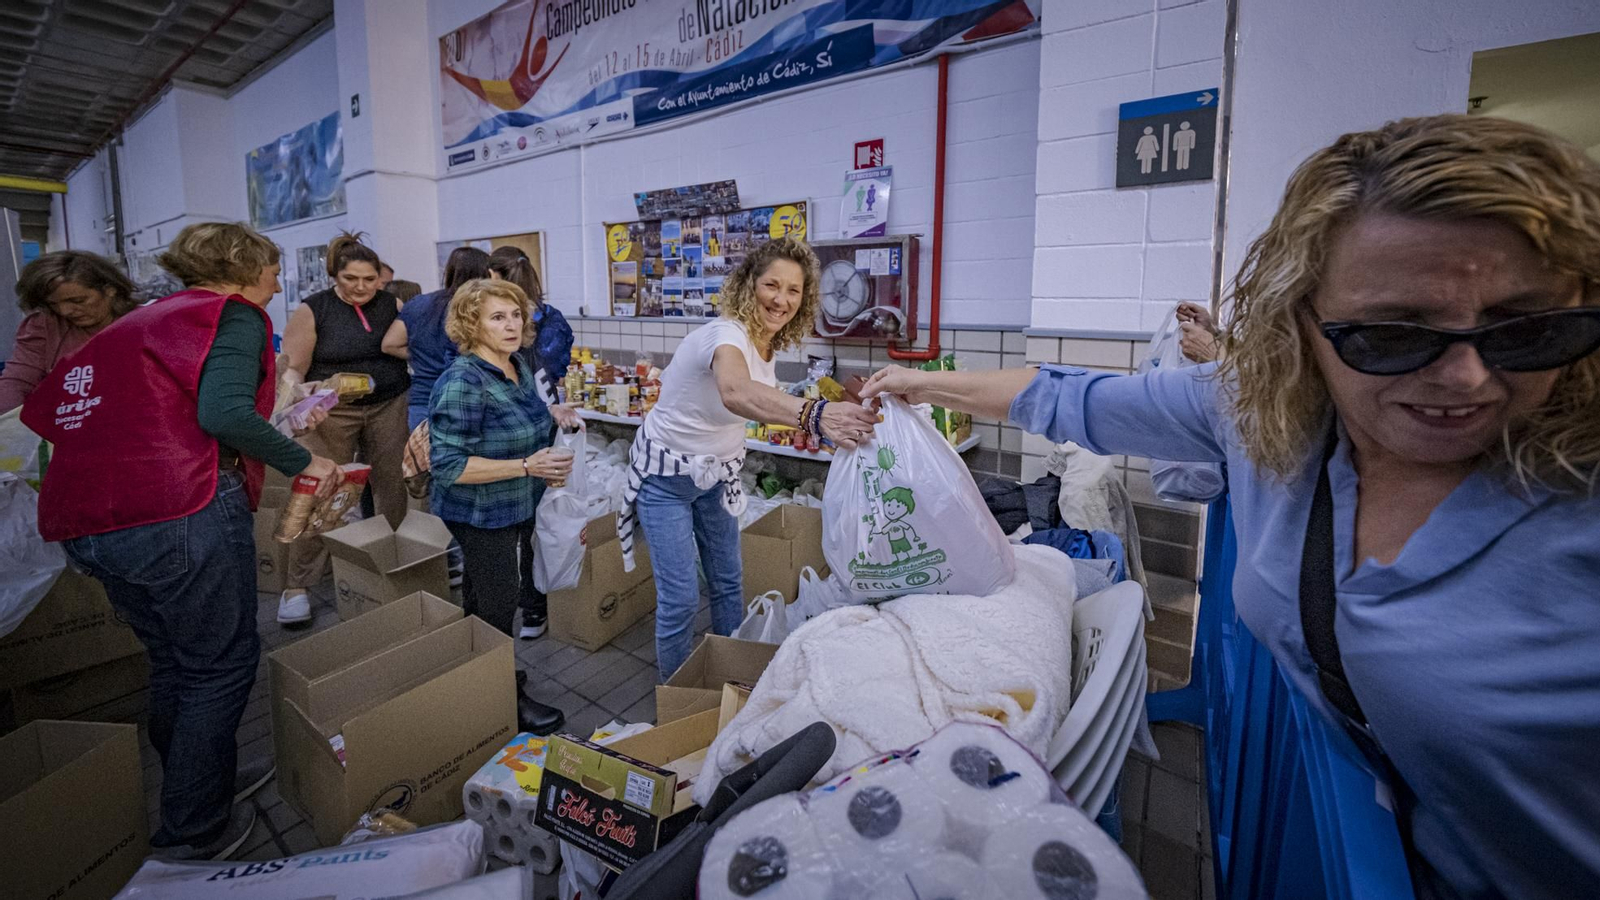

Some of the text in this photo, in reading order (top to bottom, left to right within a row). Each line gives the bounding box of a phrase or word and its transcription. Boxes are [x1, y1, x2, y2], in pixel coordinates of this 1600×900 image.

[546, 0, 636, 40] Campeona
[678, 8, 695, 43] de
[588, 64, 601, 86] del
[605, 51, 618, 77] 12
[622, 53, 631, 72] al
[636, 43, 650, 68] 15
[653, 49, 665, 67] de
[669, 48, 694, 67] Abril
[705, 28, 743, 63] Cádiz
[657, 97, 677, 111] Con
[678, 94, 688, 108] el
[687, 74, 755, 107] Ayuntamiento
[756, 72, 771, 87] de
[857, 582, 902, 590] El Club
[419, 725, 510, 786] BANCO DE ALIMENTOS
[420, 784, 433, 794] DE
[596, 807, 637, 848] Fruits
[68, 832, 136, 889] ALIMENTOS
[206, 848, 391, 882] ABS Pants
